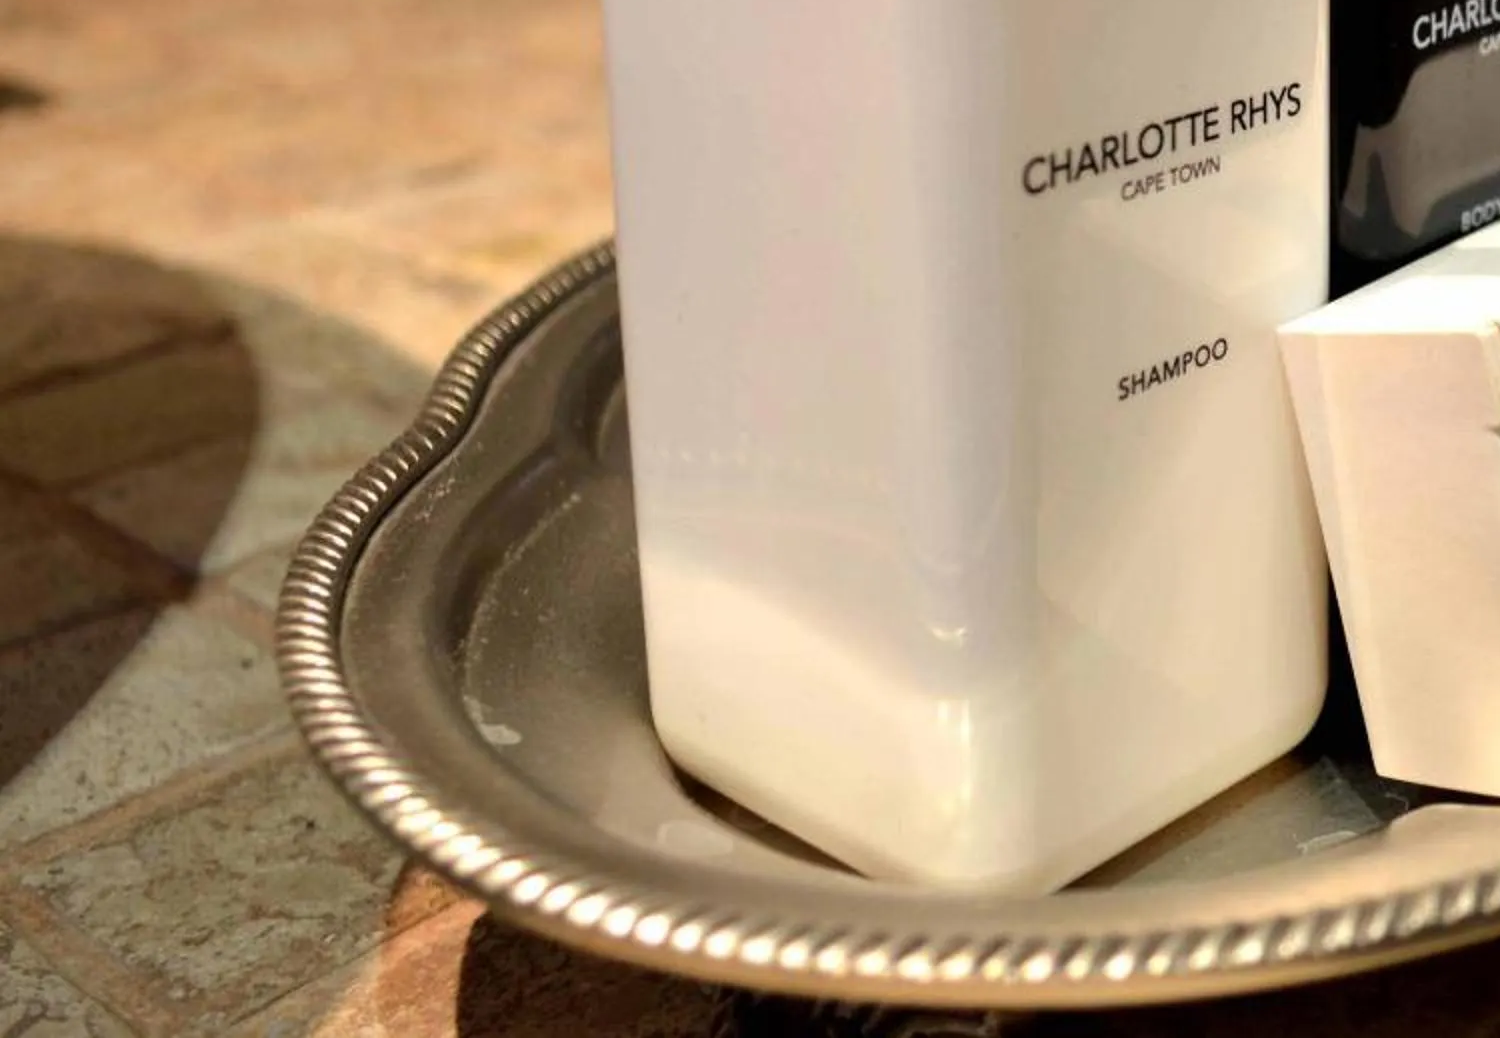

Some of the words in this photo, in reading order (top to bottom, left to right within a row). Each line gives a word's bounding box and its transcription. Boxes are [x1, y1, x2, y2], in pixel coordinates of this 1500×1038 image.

[1021, 106, 1222, 195] CHARLOTTE
[1230, 82, 1302, 134] RHYS
[1120, 173, 1166, 201] CAPE
[1170, 155, 1221, 186] TOWN
[1118, 337, 1229, 400] SHAMPOO
